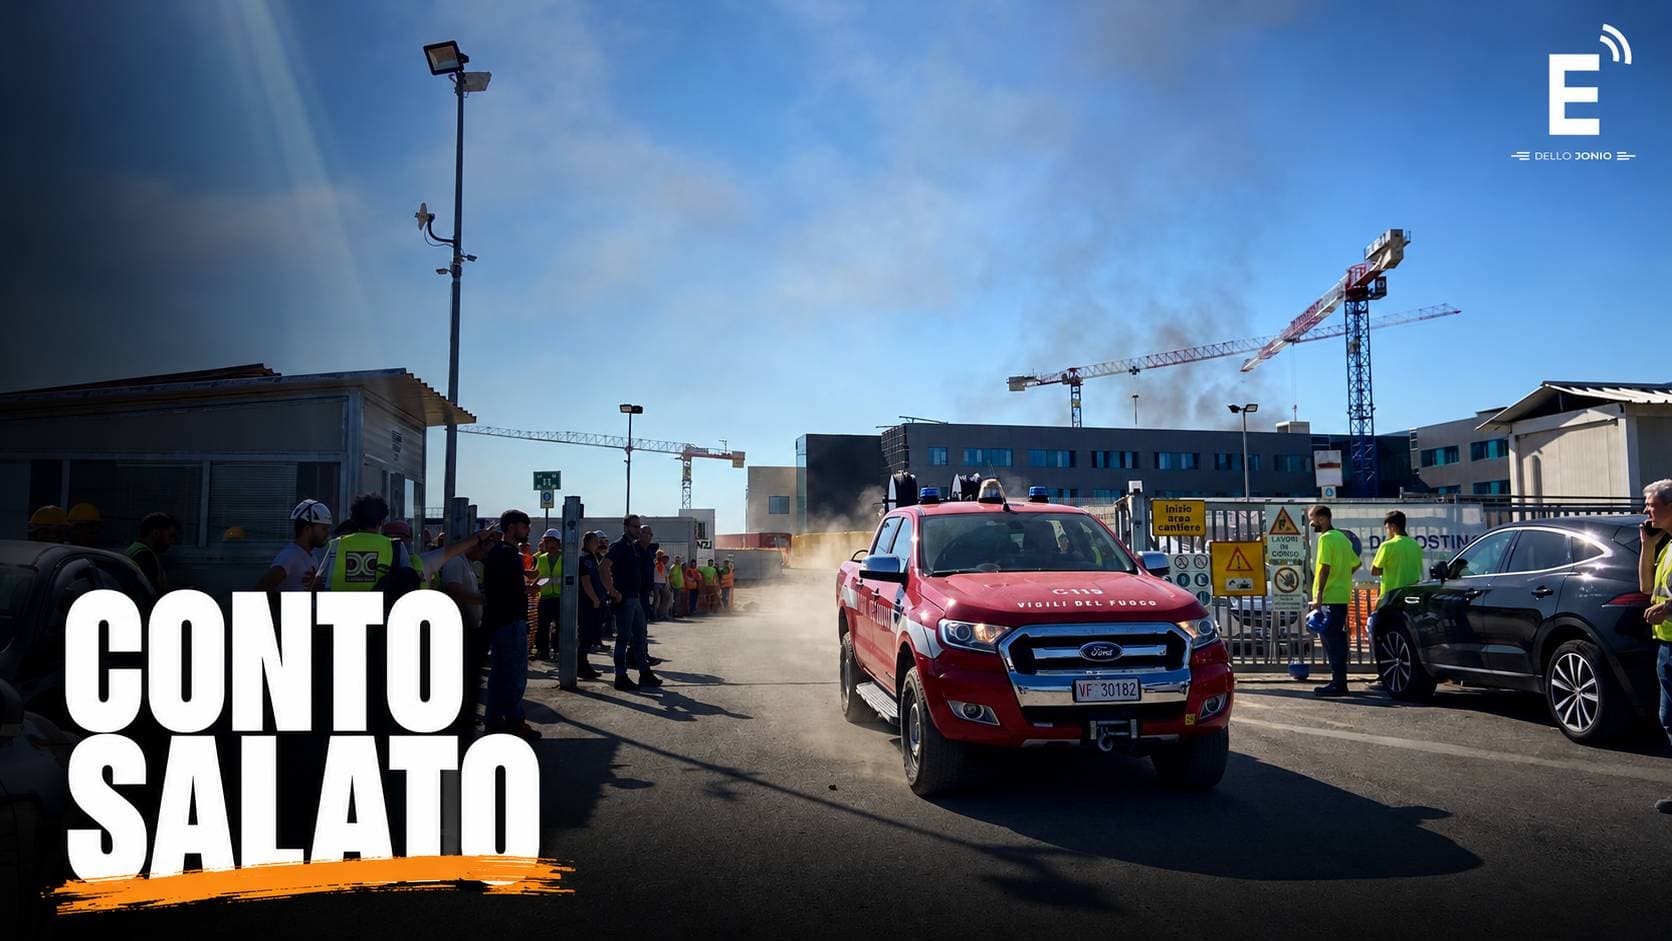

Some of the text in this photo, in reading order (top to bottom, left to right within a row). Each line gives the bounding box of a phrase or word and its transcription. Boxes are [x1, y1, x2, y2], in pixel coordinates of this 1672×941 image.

[1158, 523, 1201, 531] cantiere
[1016, 599, 1157, 609] VIGILI DEL FUOCO
[1078, 682, 1137, 698] VF 30182
